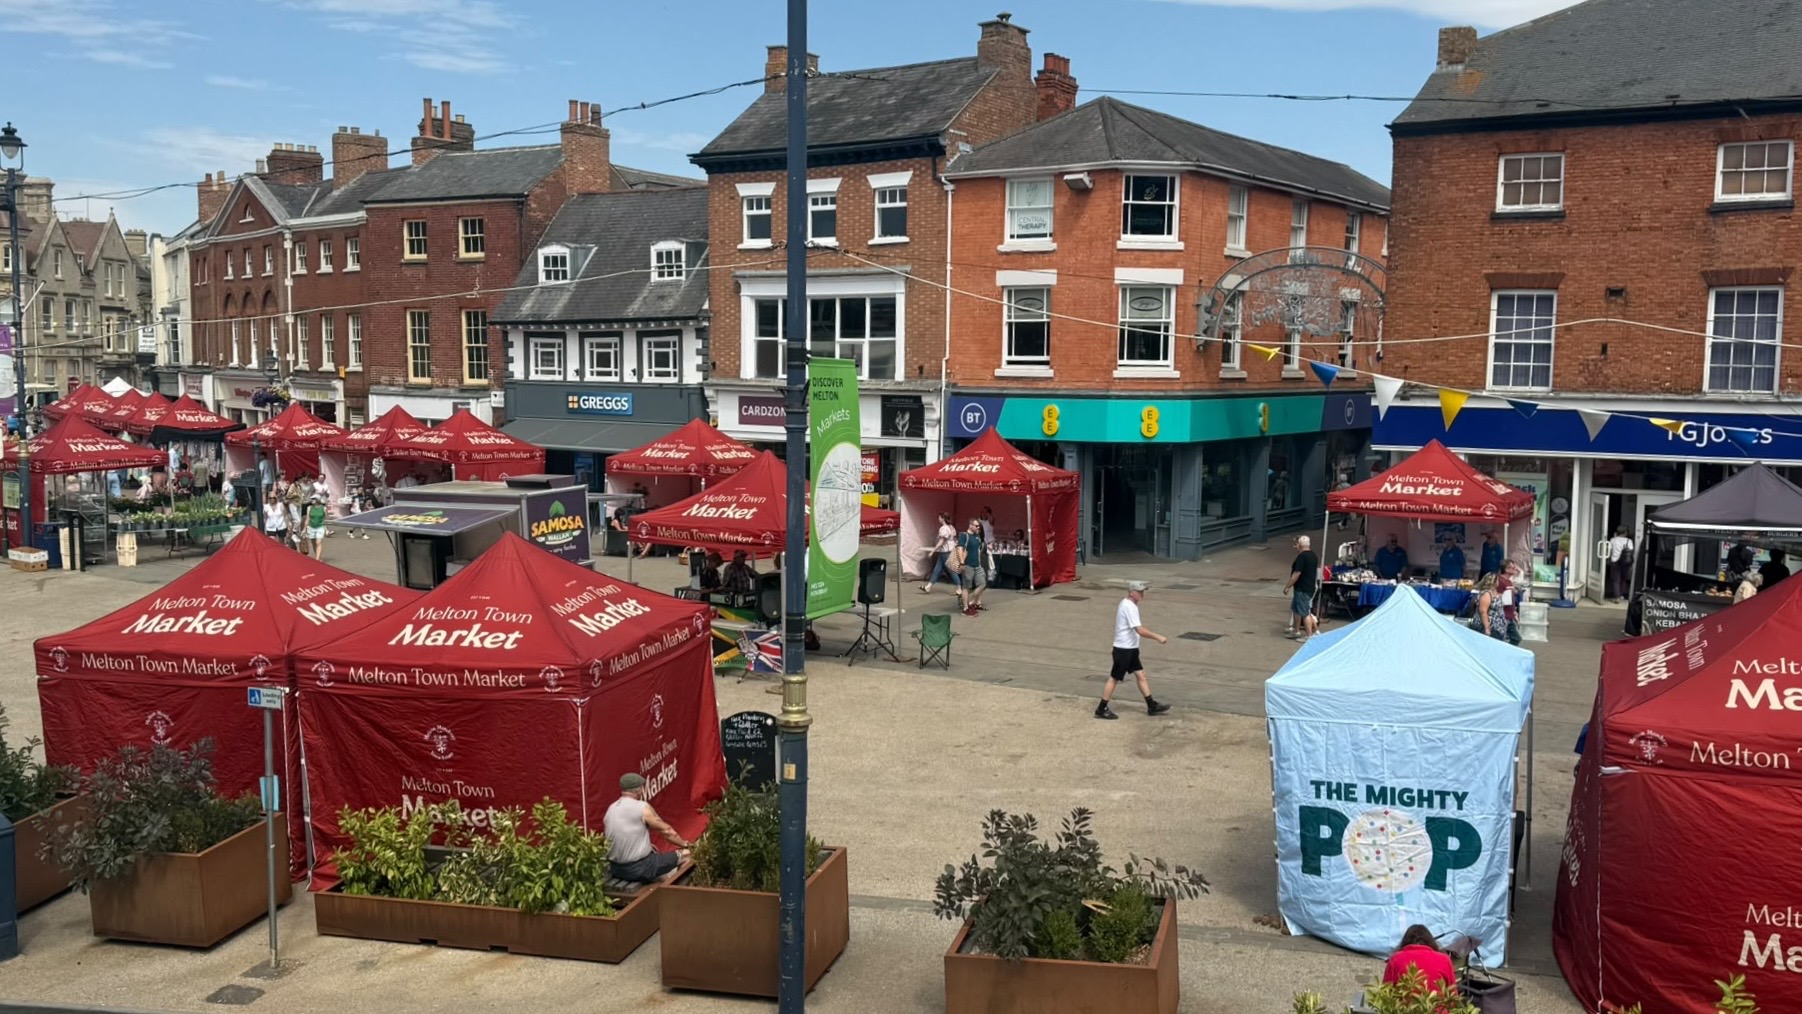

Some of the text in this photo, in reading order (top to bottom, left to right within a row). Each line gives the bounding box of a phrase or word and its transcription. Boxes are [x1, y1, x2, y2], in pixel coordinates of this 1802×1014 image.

[812, 377, 843, 388] DISCOVER
[580, 396, 629, 411] GREGGS
[812, 391, 839, 401] MELTON
[176, 414, 219, 423] Market
[741, 405, 787, 418] CARDZON
[966, 411, 981, 424] BT
[816, 408, 850, 437] Markets
[347, 432, 381, 441] Market
[408, 435, 447, 444] Market
[468, 436, 514, 446] Market
[69, 442, 129, 453] Market
[640, 448, 690, 459] Market
[652, 442, 696, 451] Melton Town
[471, 451, 530, 460] Melton Town Market
[711, 450, 755, 460] Market
[949, 454, 1004, 464] Melton Town
[623, 463, 684, 472] Melton Town Market
[939, 461, 1001, 473] Market
[921, 478, 1003, 490] Melton Town Market
[1386, 474, 1430, 484] Melton
[1431, 475, 1464, 486] Town
[1379, 483, 1463, 496] Market
[700, 493, 767, 504] Melton Town
[681, 503, 758, 520] Market
[1358, 500, 1473, 515] Melton Town Market
[531, 515, 585, 537] SAMOSA
[656, 526, 753, 543] Melton Town Market
[281, 577, 365, 605] Melton Town
[149, 594, 255, 611] Melton Town
[296, 588, 394, 625] Market
[549, 582, 621, 617] Melton Town
[1645, 599, 1687, 610] SAMOSA
[413, 606, 533, 625] Melton Town
[568, 597, 651, 637] Market
[1645, 608, 1676, 618] ONION
[121, 610, 244, 635] Market
[388, 623, 524, 650] Market
[609, 649, 639, 676] Melton
[637, 639, 662, 663] Town
[662, 627, 691, 655] Market
[81, 653, 134, 672] Melton
[136, 655, 178, 674] Town
[182, 658, 239, 676] Market
[1636, 637, 1680, 687] Market
[348, 666, 408, 685] Melton
[411, 668, 459, 687] Town
[463, 670, 526, 687] Market
[262, 691, 280, 700] Loading
[1724, 678, 1802, 712] Ma
[639, 738, 678, 773] Melton Town
[1690, 741, 1791, 769] Melton
[402, 775, 495, 798] Melton Town
[1310, 780, 1469, 811] THE MIGHTY
[1745, 903, 1802, 928] Melt
[1737, 930, 1802, 973] Ma
